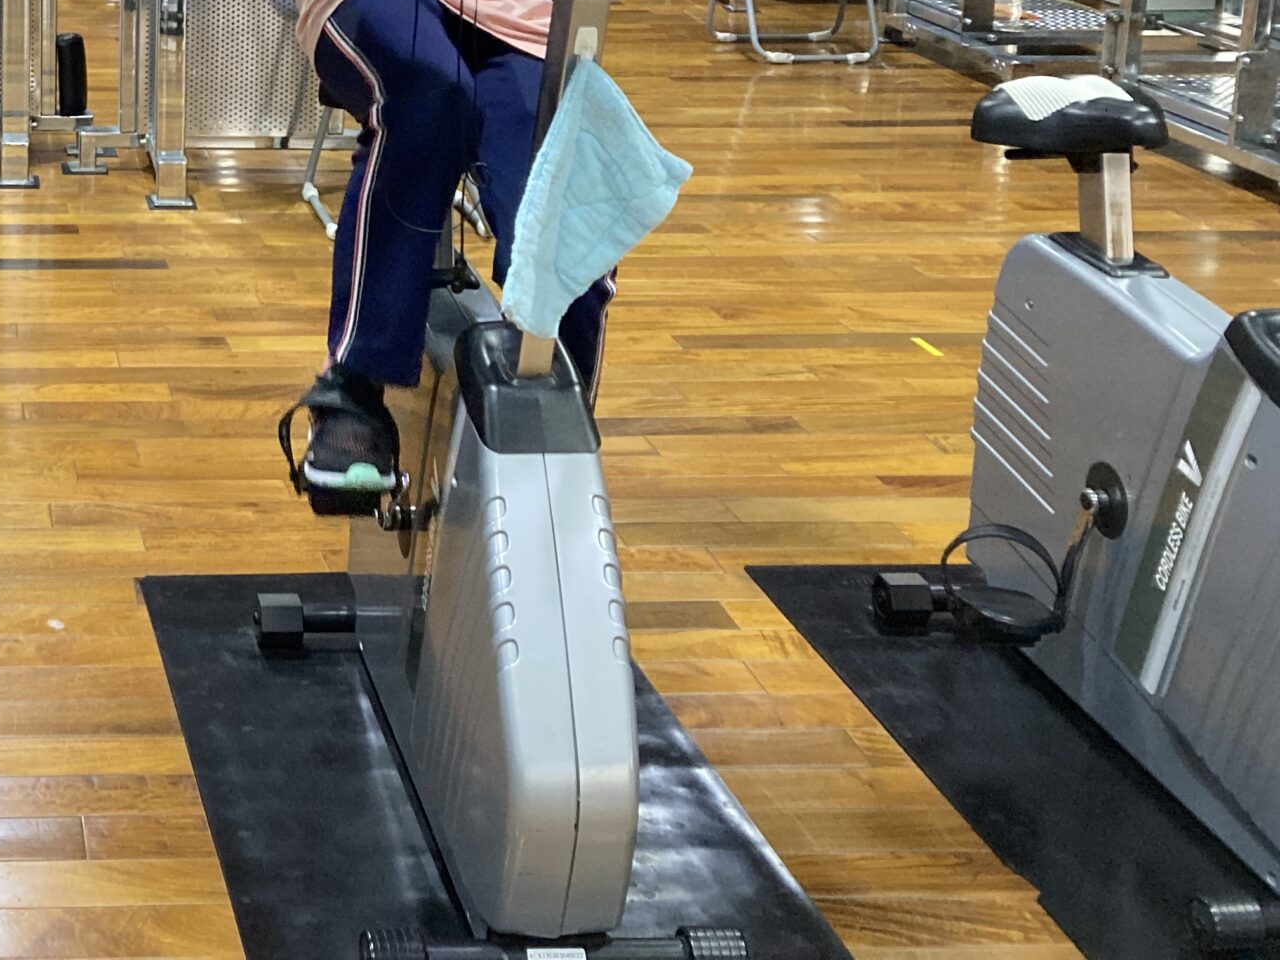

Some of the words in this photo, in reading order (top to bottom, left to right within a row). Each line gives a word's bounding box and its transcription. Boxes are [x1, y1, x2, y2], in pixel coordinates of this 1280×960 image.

[1176, 439, 1203, 488] V
[1176, 491, 1194, 530] BIKE
[1154, 522, 1184, 591] CORDLESS
